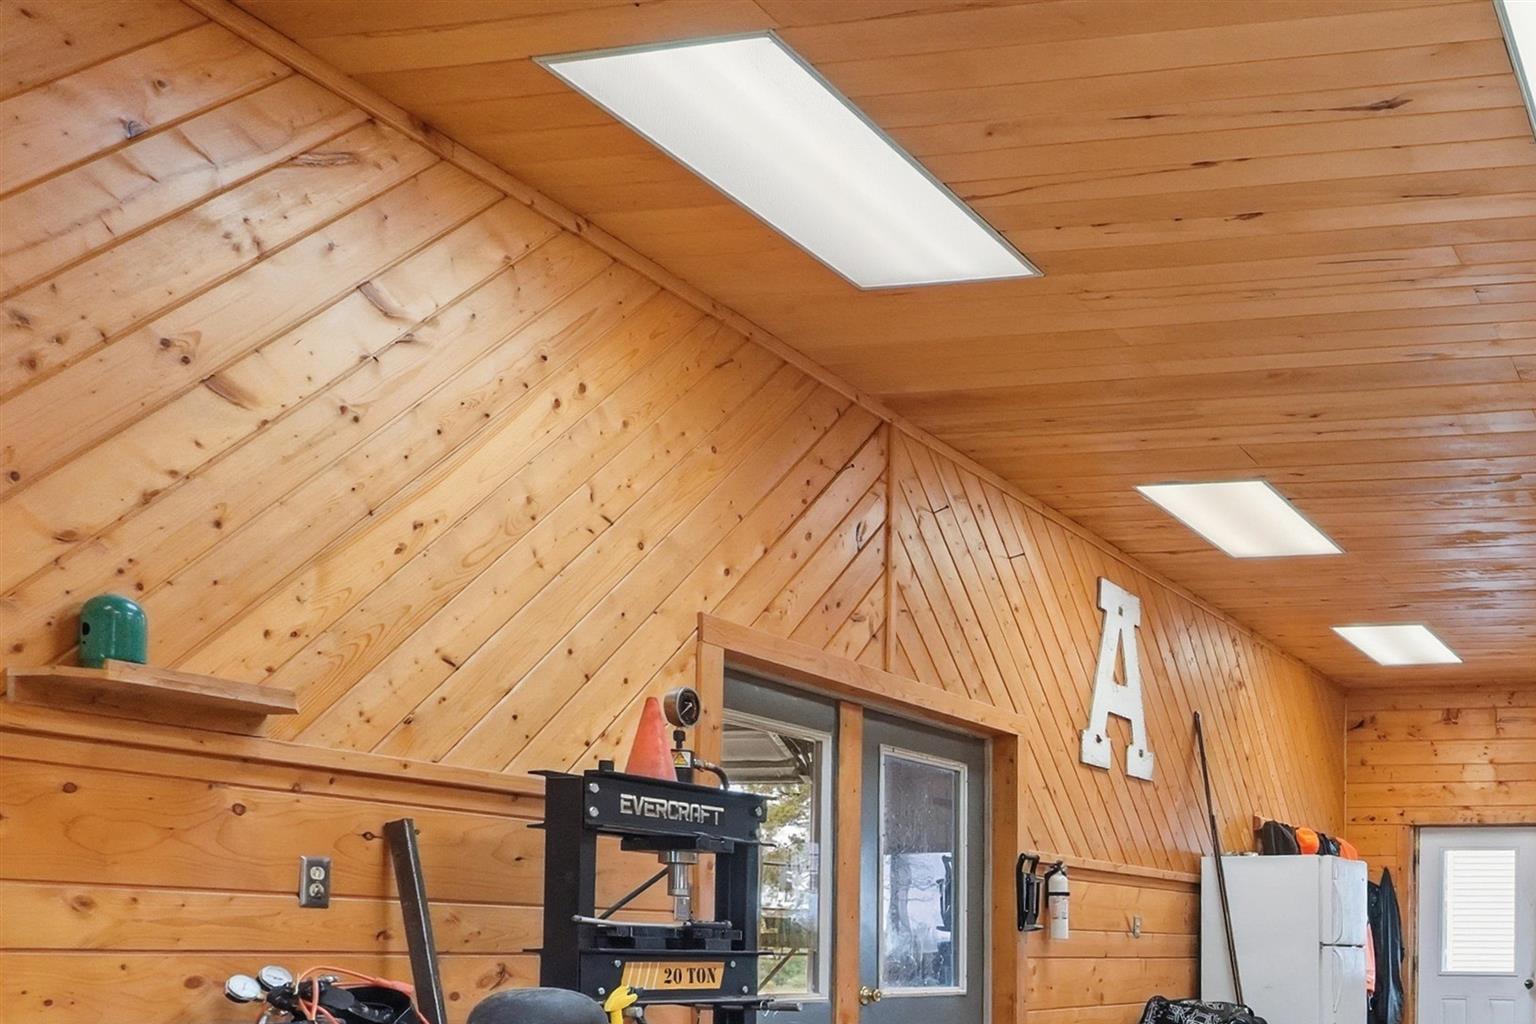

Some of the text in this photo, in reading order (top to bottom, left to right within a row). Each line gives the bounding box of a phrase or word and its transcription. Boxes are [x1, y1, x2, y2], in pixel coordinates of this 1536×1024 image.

[1079, 576, 1154, 782] A
[620, 793, 725, 826] EVERCRAFT
[663, 967, 717, 984] 20 TON
